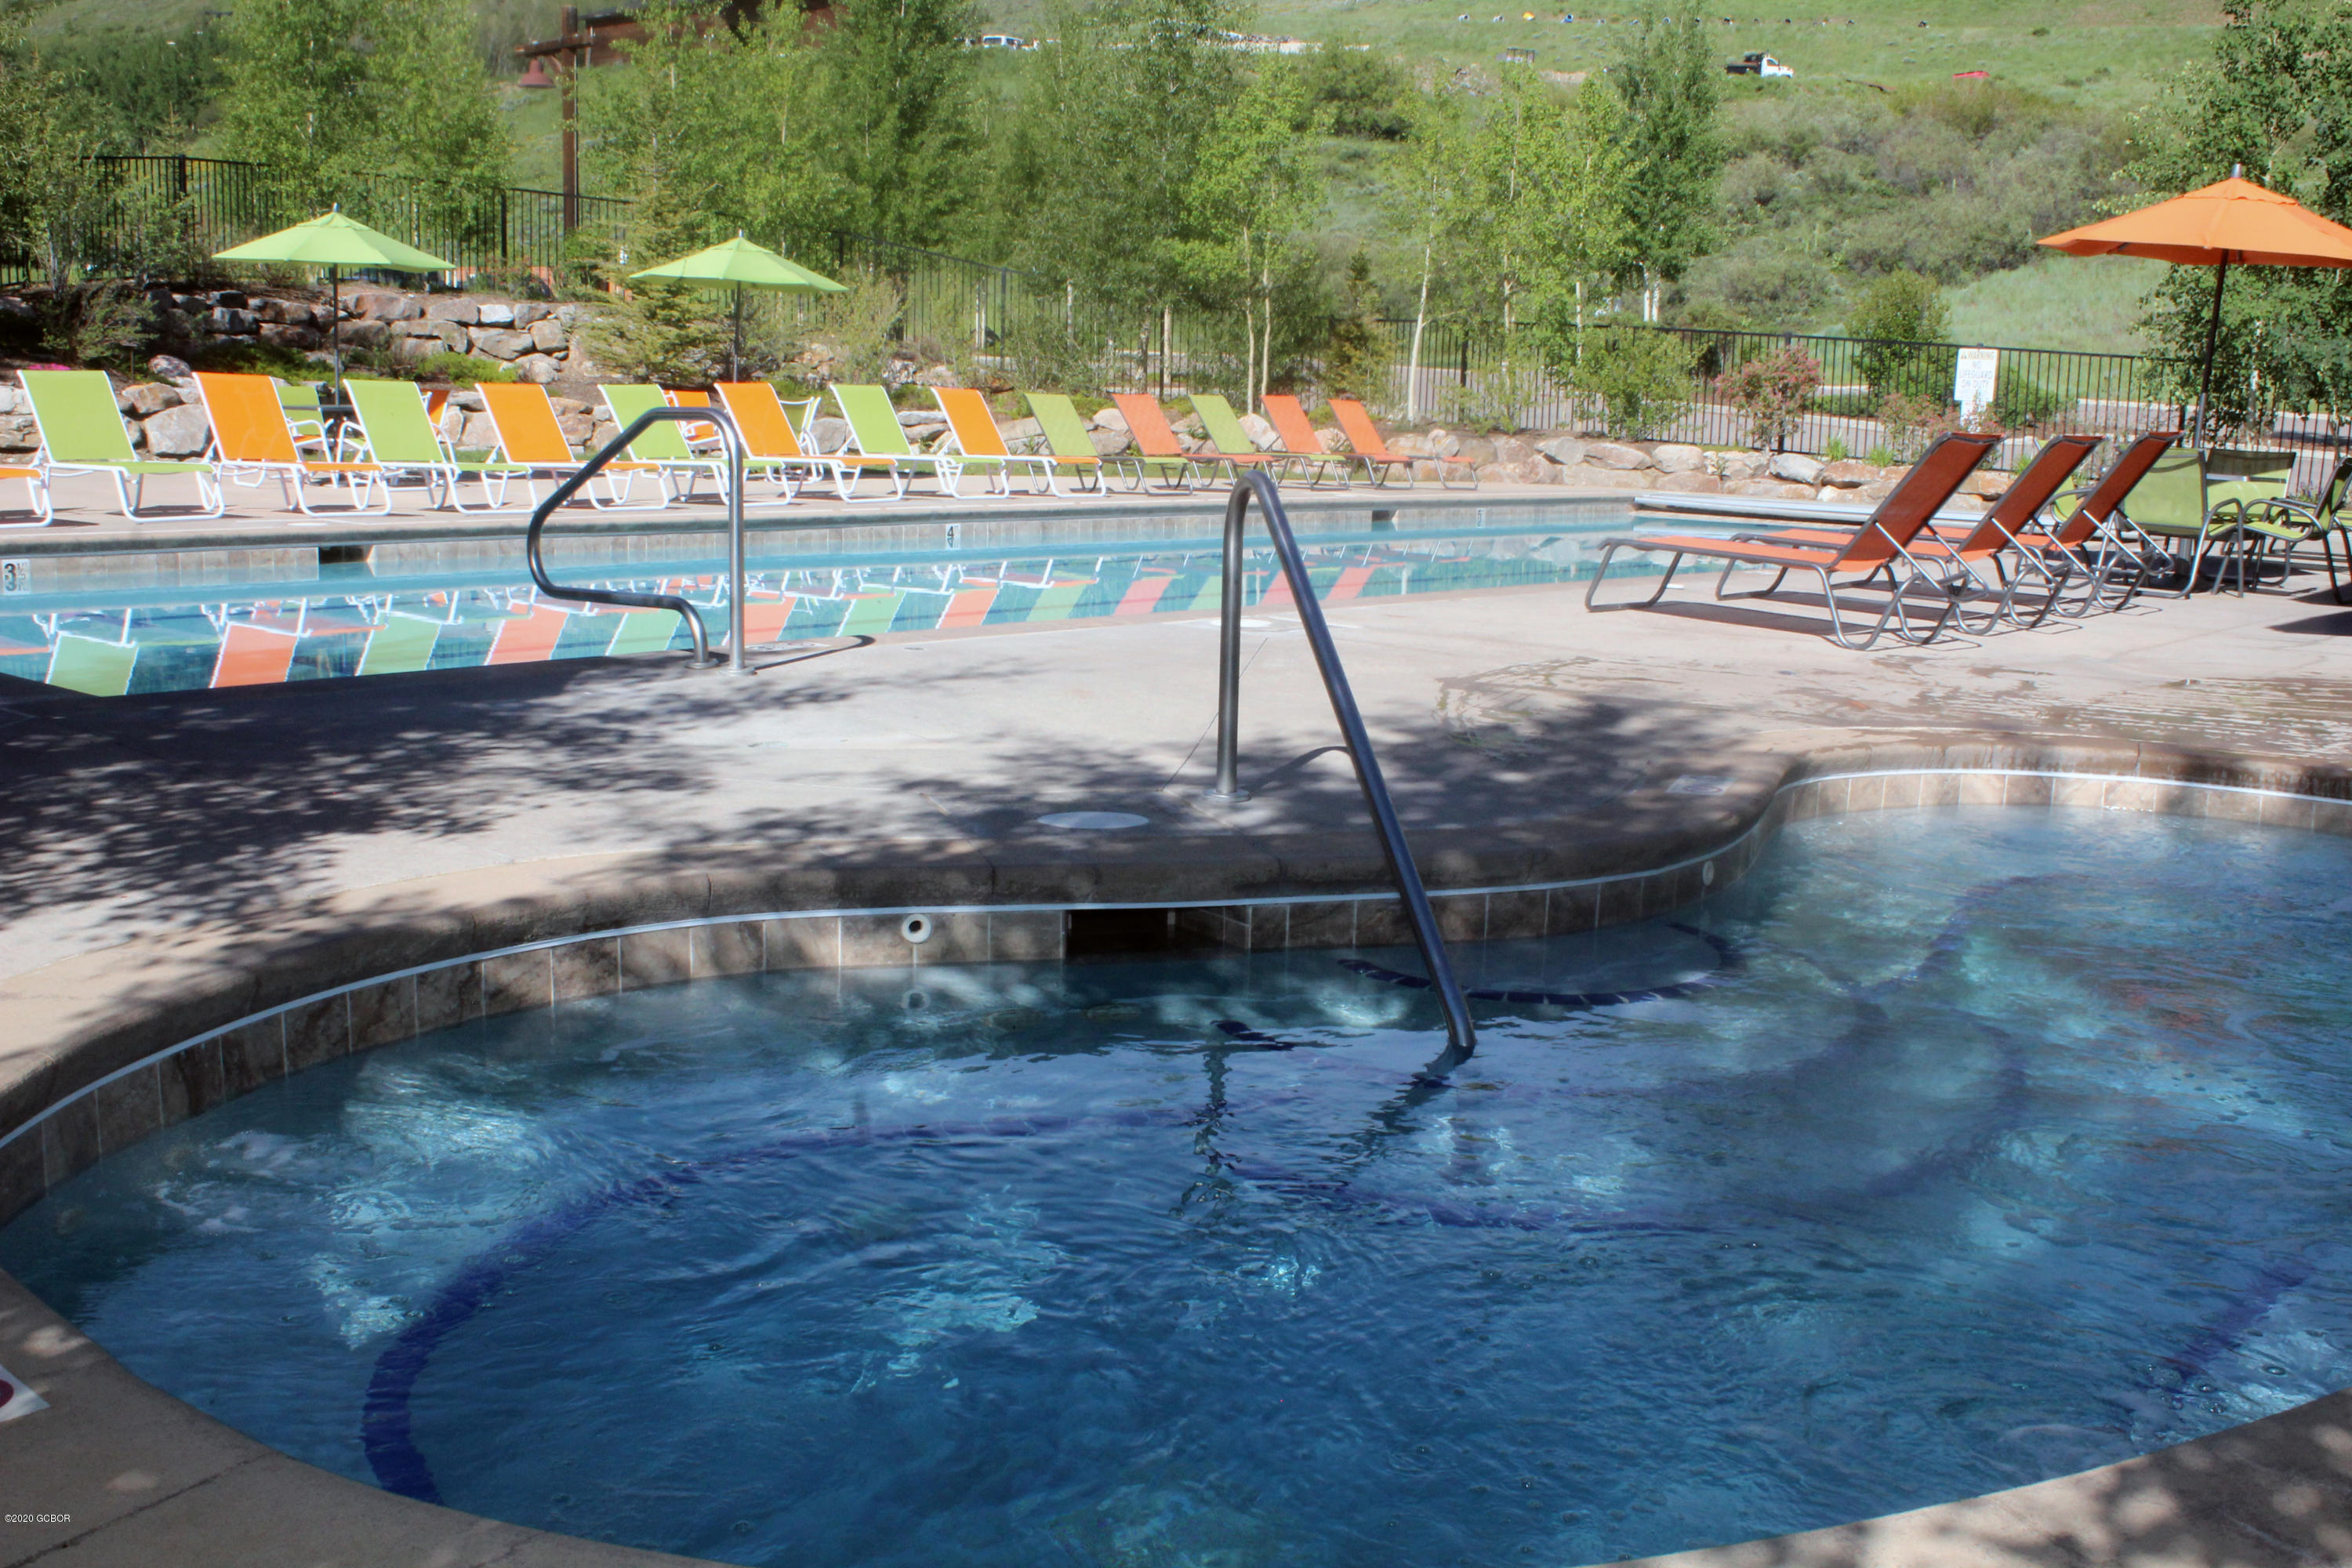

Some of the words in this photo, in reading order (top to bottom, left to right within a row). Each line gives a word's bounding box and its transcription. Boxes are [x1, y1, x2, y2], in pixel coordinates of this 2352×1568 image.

[1968, 350, 1994, 359] WARNING
[1959, 370, 1993, 379] LIFEGUARD
[1962, 379, 1971, 388] ON
[1973, 379, 1989, 389] DUTY
